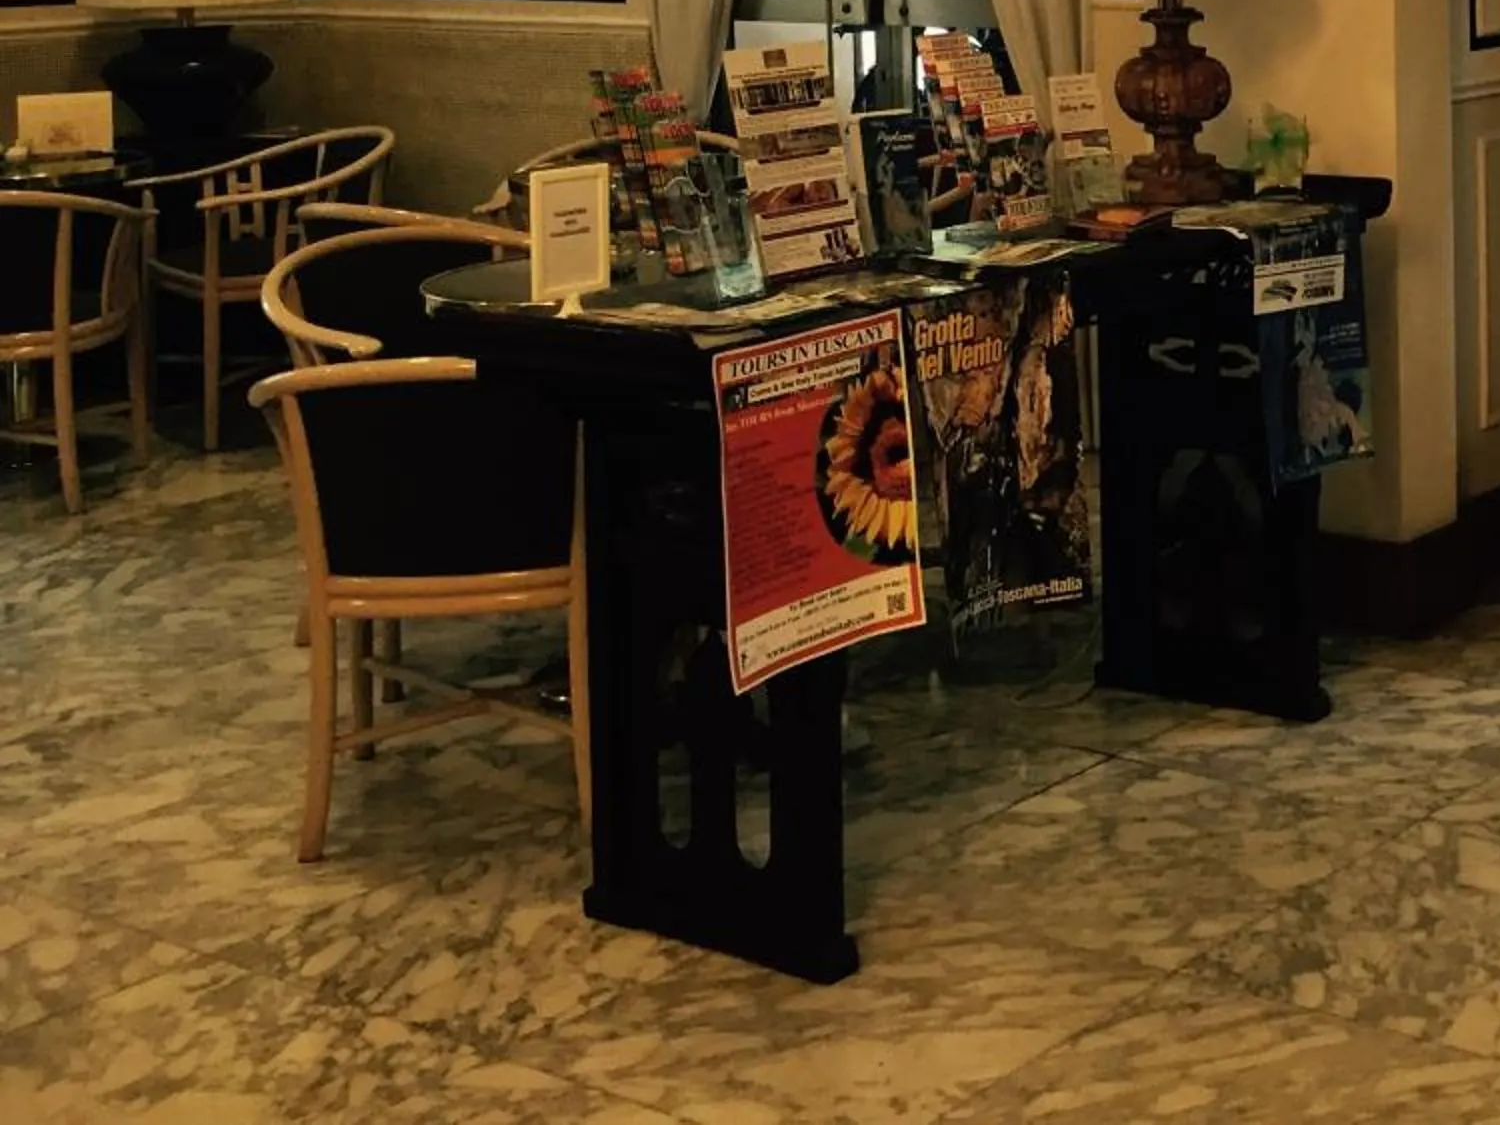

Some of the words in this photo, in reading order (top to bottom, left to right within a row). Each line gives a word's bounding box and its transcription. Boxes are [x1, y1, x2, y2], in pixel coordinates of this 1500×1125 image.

[914, 312, 975, 351] Grotta
[731, 350, 787, 377] TOURS
[791, 345, 809, 363] IN
[813, 327, 884, 357] TUSCANY
[949, 336, 1002, 373] Vento
